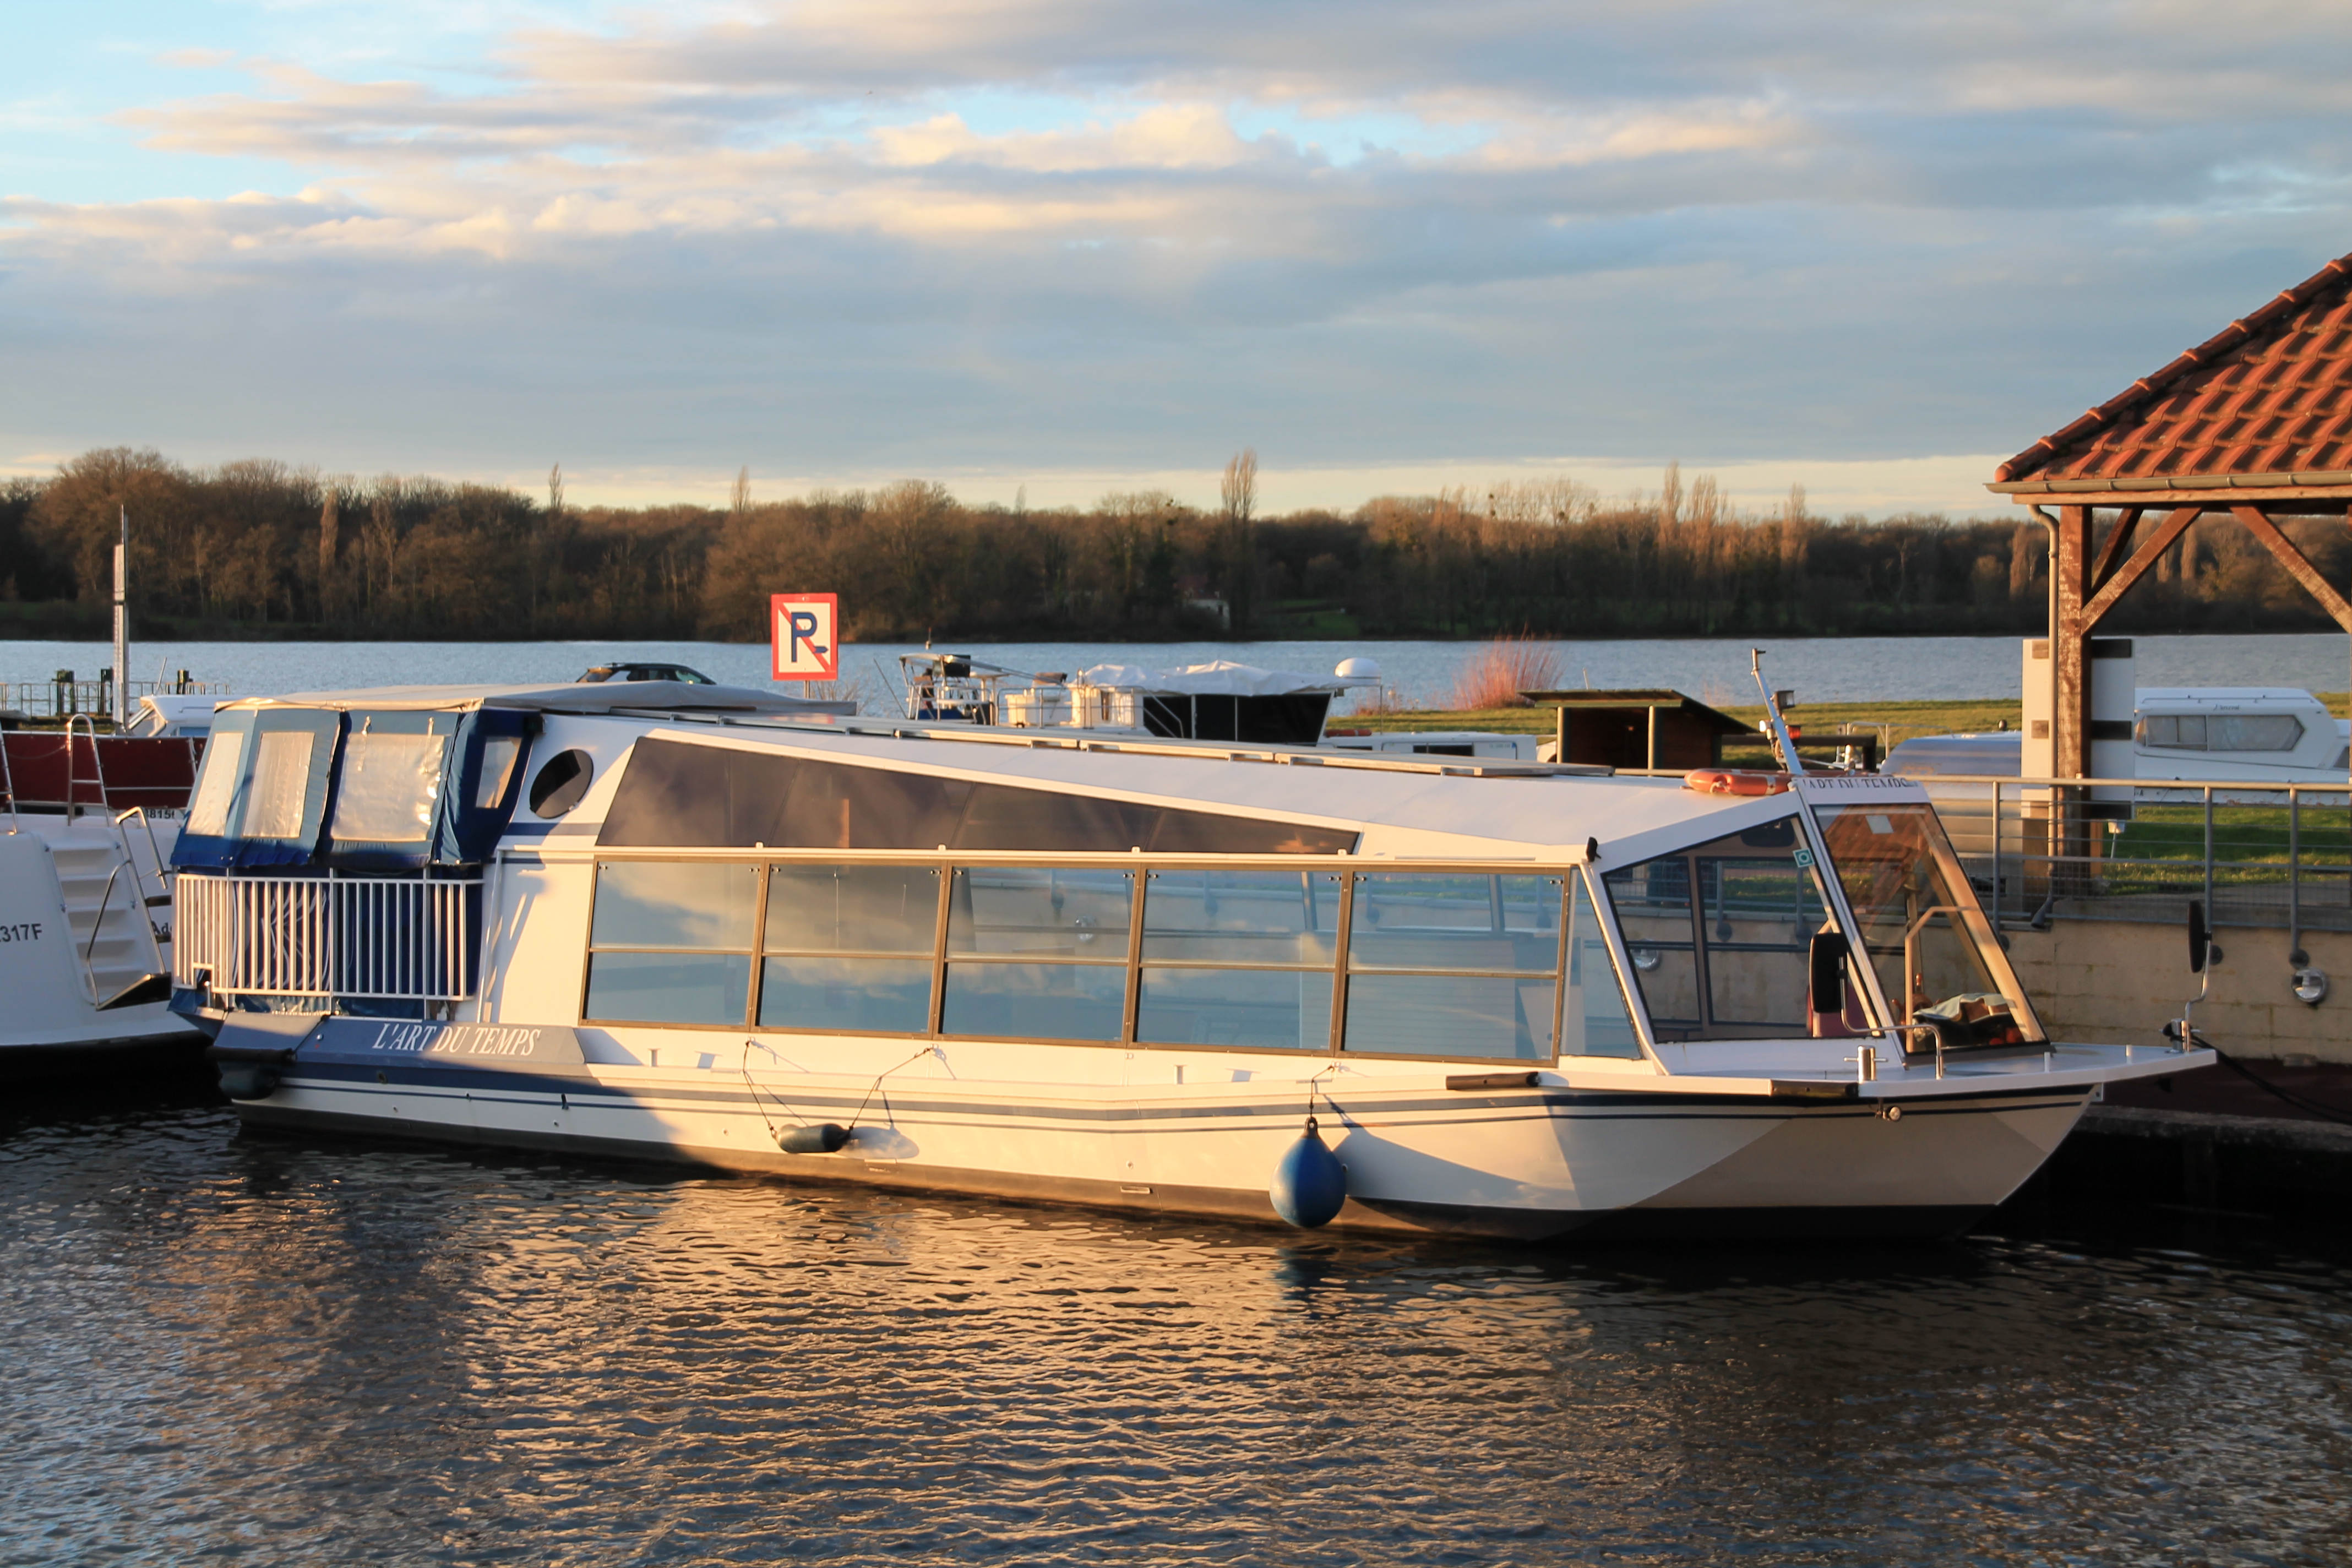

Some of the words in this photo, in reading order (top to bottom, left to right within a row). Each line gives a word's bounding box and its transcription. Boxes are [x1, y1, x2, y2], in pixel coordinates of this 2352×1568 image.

[791, 612, 818, 663] P
[145, 809, 175, 819] 815
[0, 923, 42, 942] 317F
[150, 920, 172, 935] Ad
[372, 1023, 437, 1052] L'ART
[432, 1025, 471, 1053] DU
[468, 1027, 542, 1056] TEMPS
